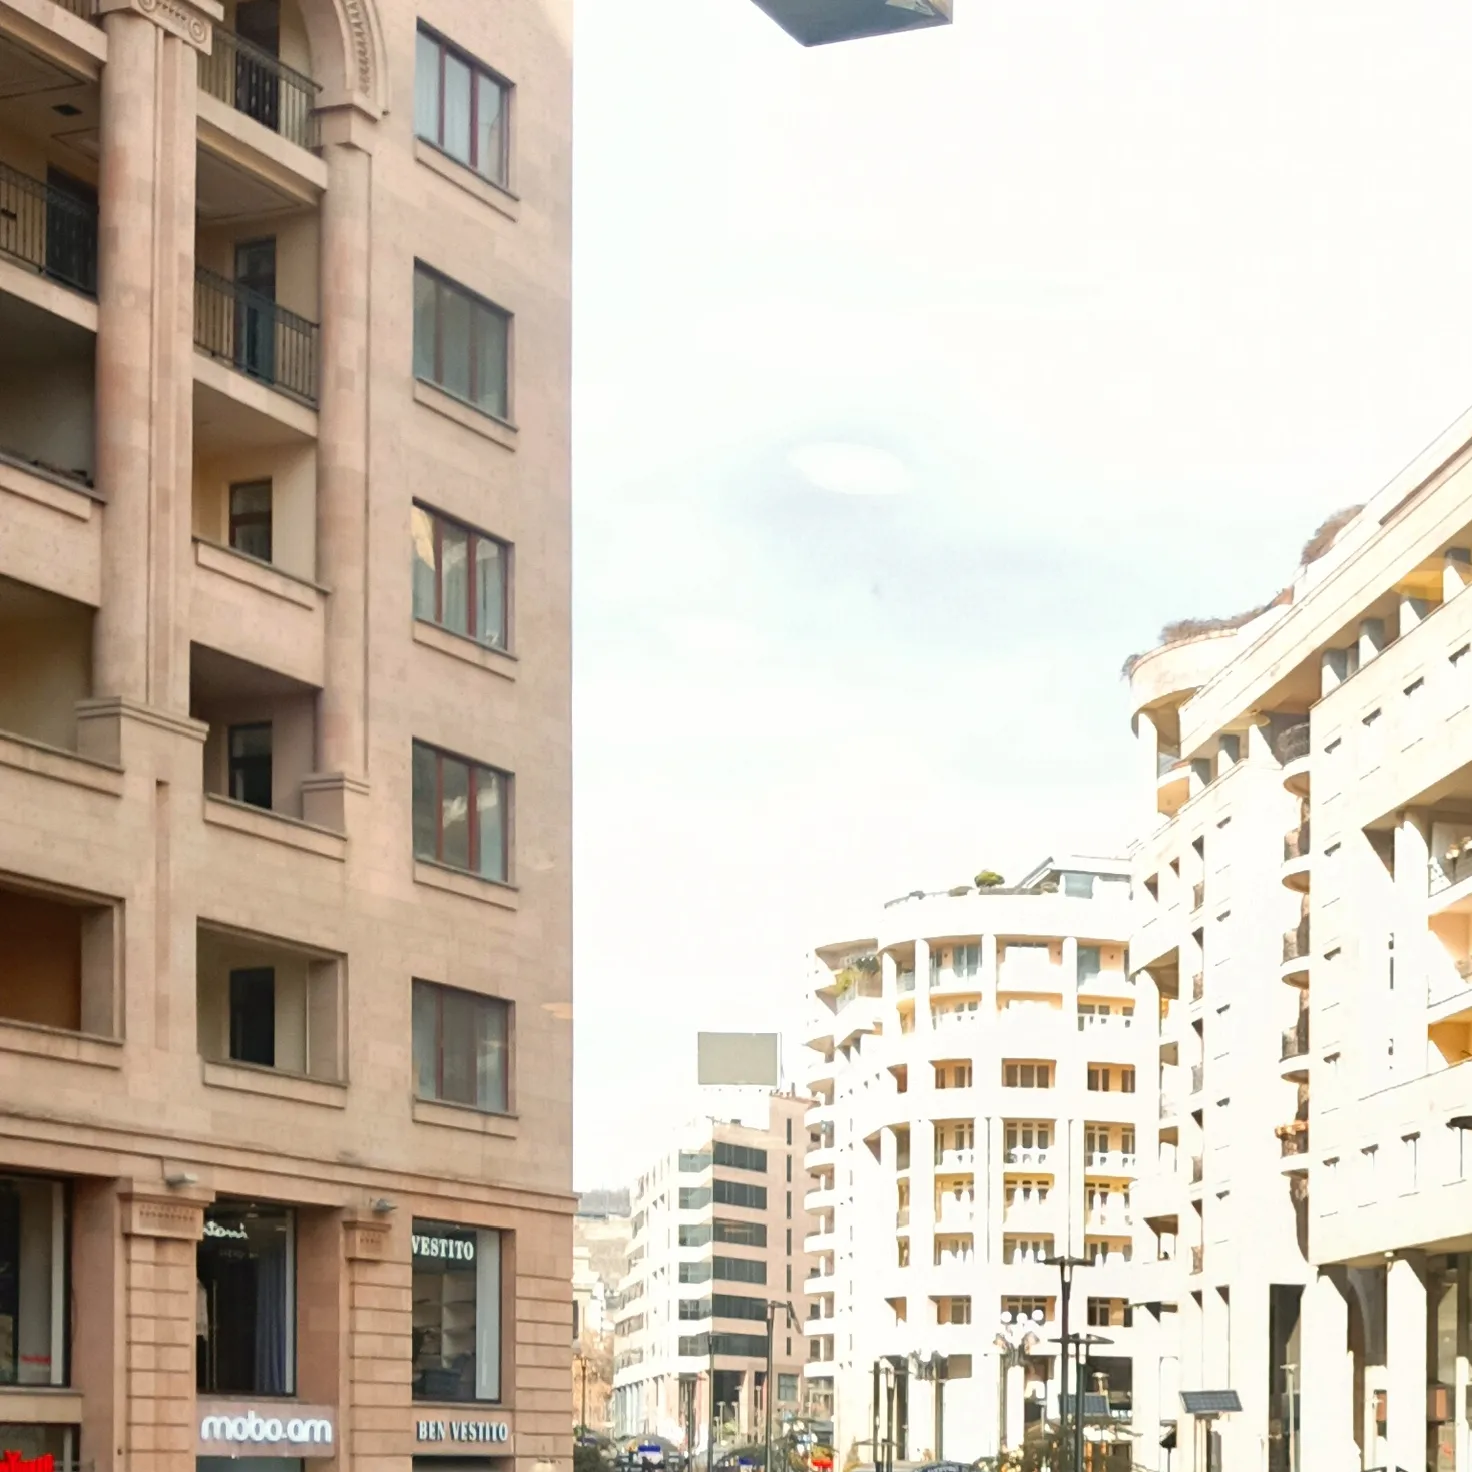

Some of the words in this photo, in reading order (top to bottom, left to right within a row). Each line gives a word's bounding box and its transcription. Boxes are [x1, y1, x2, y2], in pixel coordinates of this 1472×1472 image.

[412, 1234, 474, 1261] VESTITO
[201, 1409, 332, 1443] mobo.am
[417, 1420, 446, 1442] BEN
[449, 1421, 509, 1443] VESTITO
